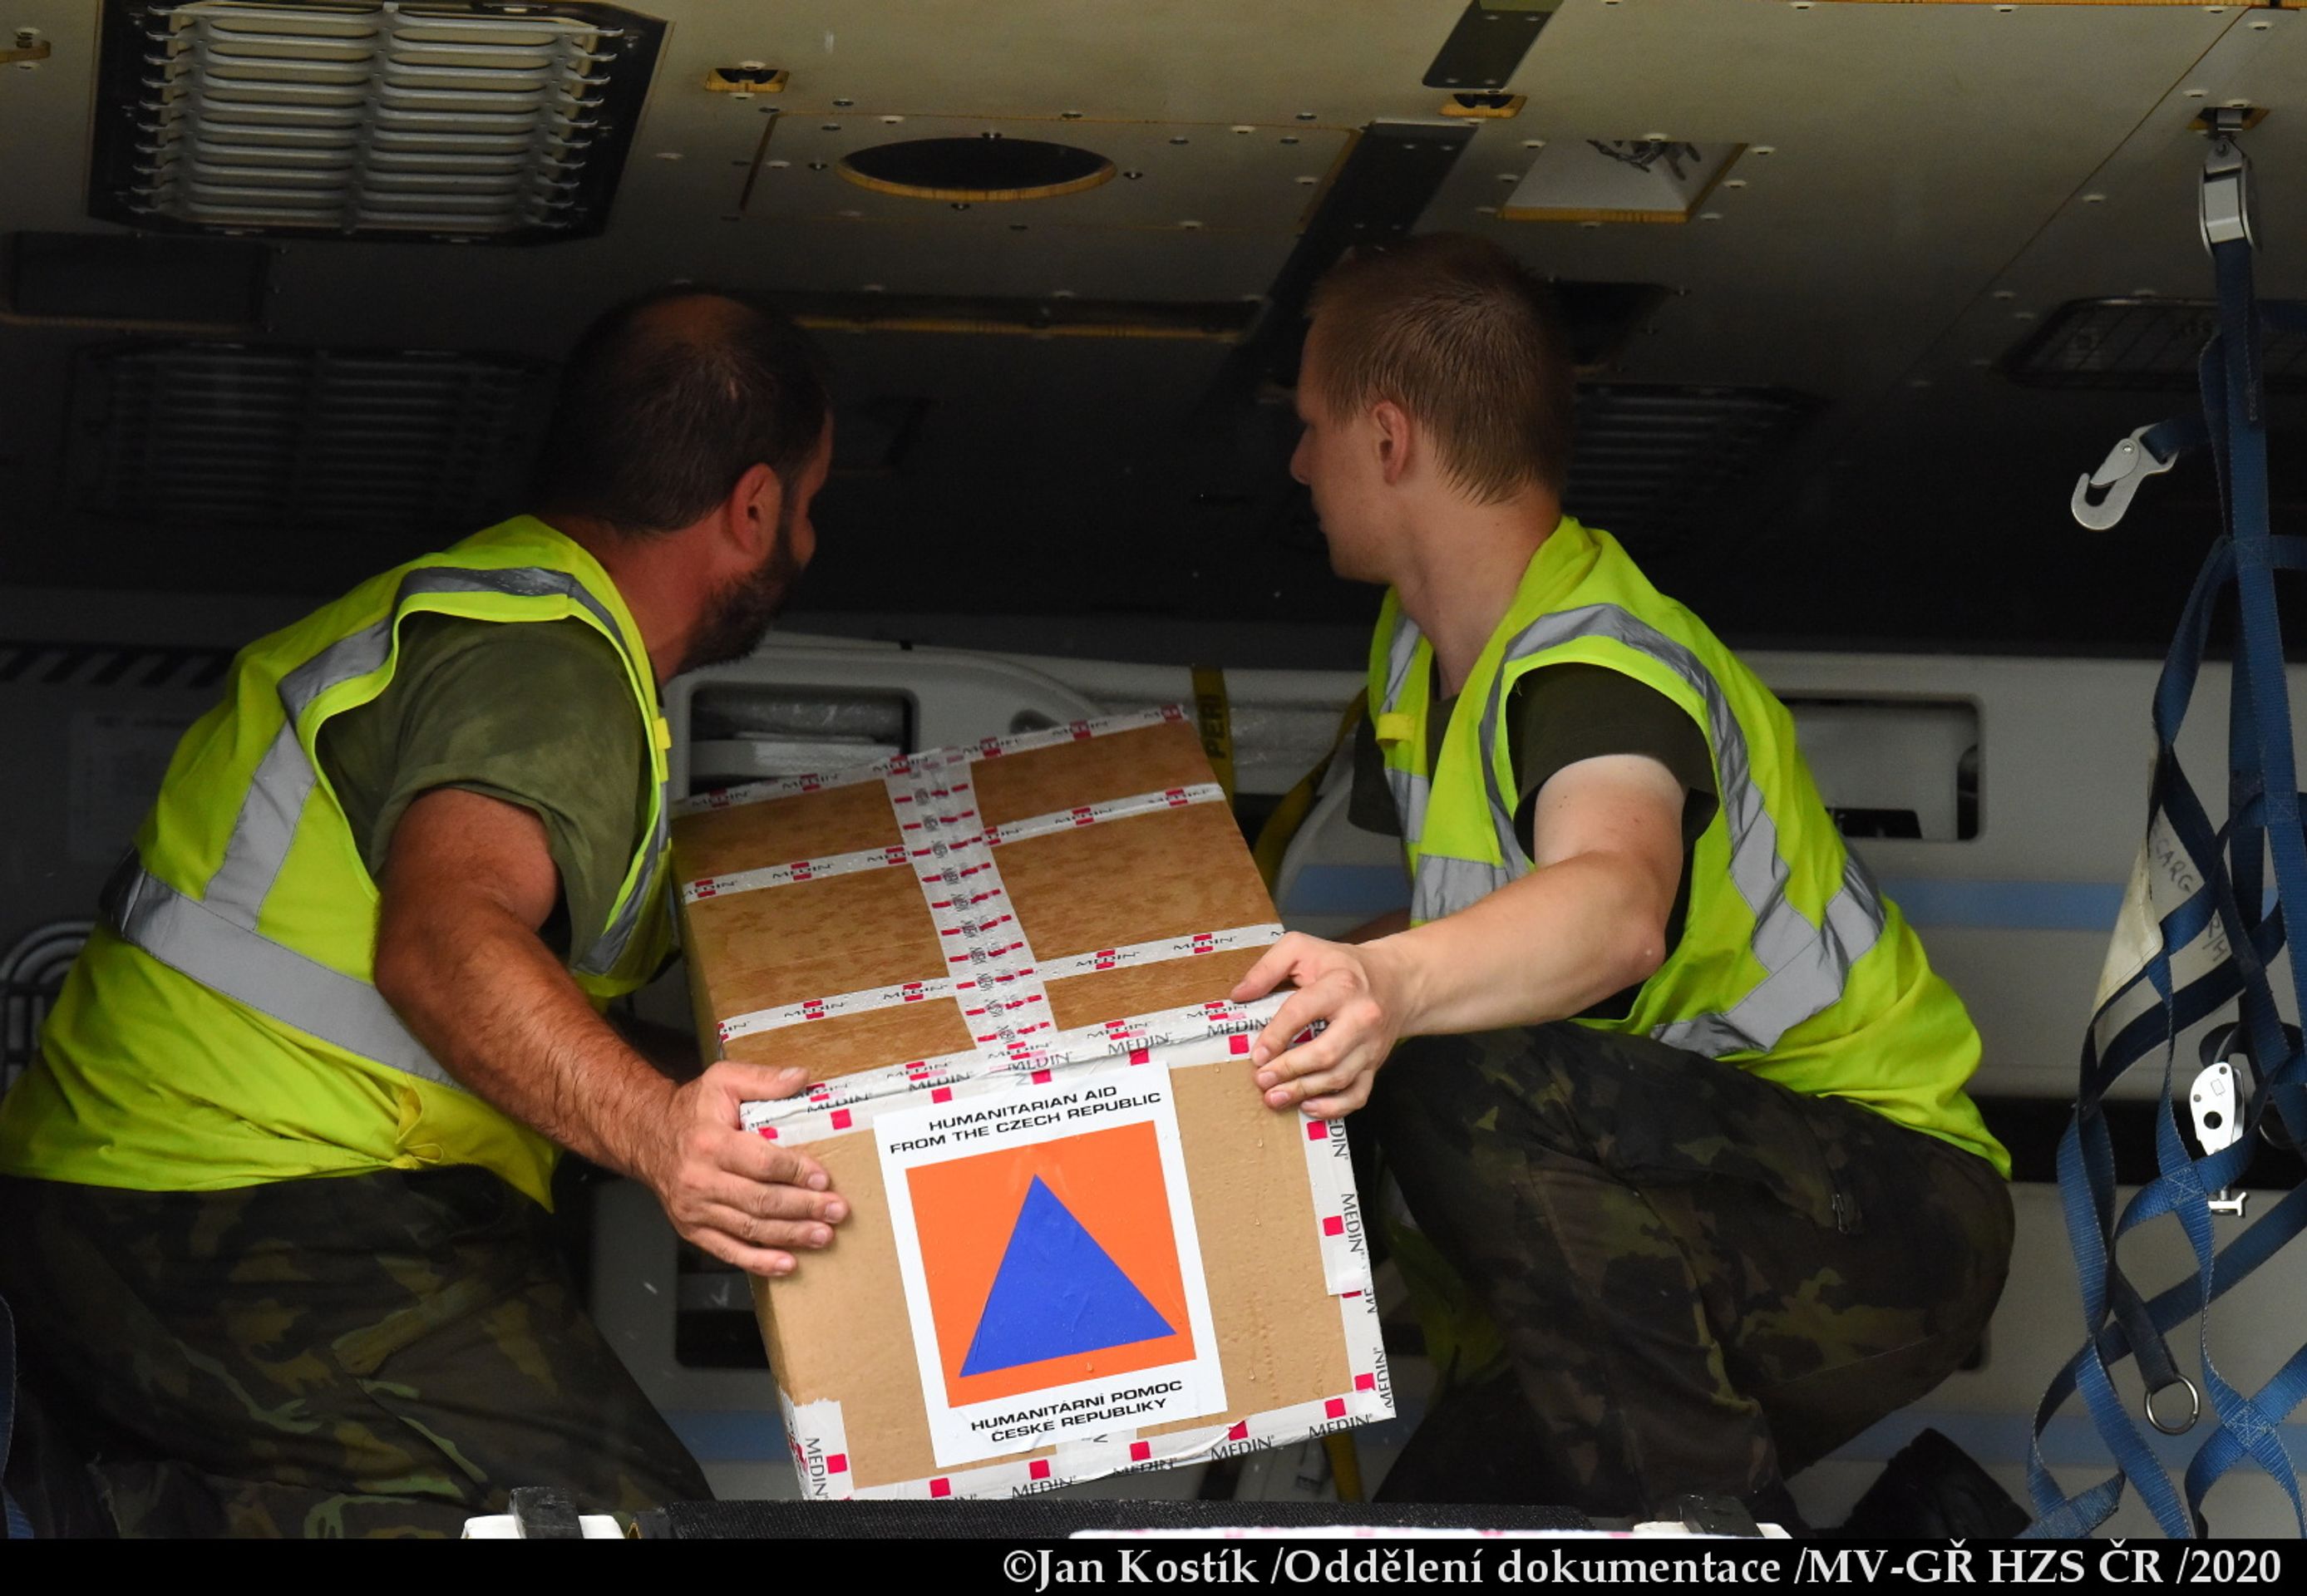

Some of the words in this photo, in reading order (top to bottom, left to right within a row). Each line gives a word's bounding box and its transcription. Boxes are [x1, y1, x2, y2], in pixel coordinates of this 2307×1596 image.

[2156, 839, 2194, 894] CARG
[890, 1135, 947, 1154] FROM
[952, 1126, 990, 1142] THE
[995, 1112, 1062, 1133] CZECH
[1067, 1092, 1161, 1119] REPUBLIC
[929, 1093, 1077, 1130] HUMANITARIAN
[1083, 1086, 1117, 1101] AID
[1060, 1398, 1167, 1427] REPUBLIKY
[1111, 1380, 1183, 1402] POMOC
[1210, 1436, 1272, 1461] MEDIN
[1309, 1414, 1370, 1439] MEDIN
[805, 1436, 828, 1497] MEDIN
